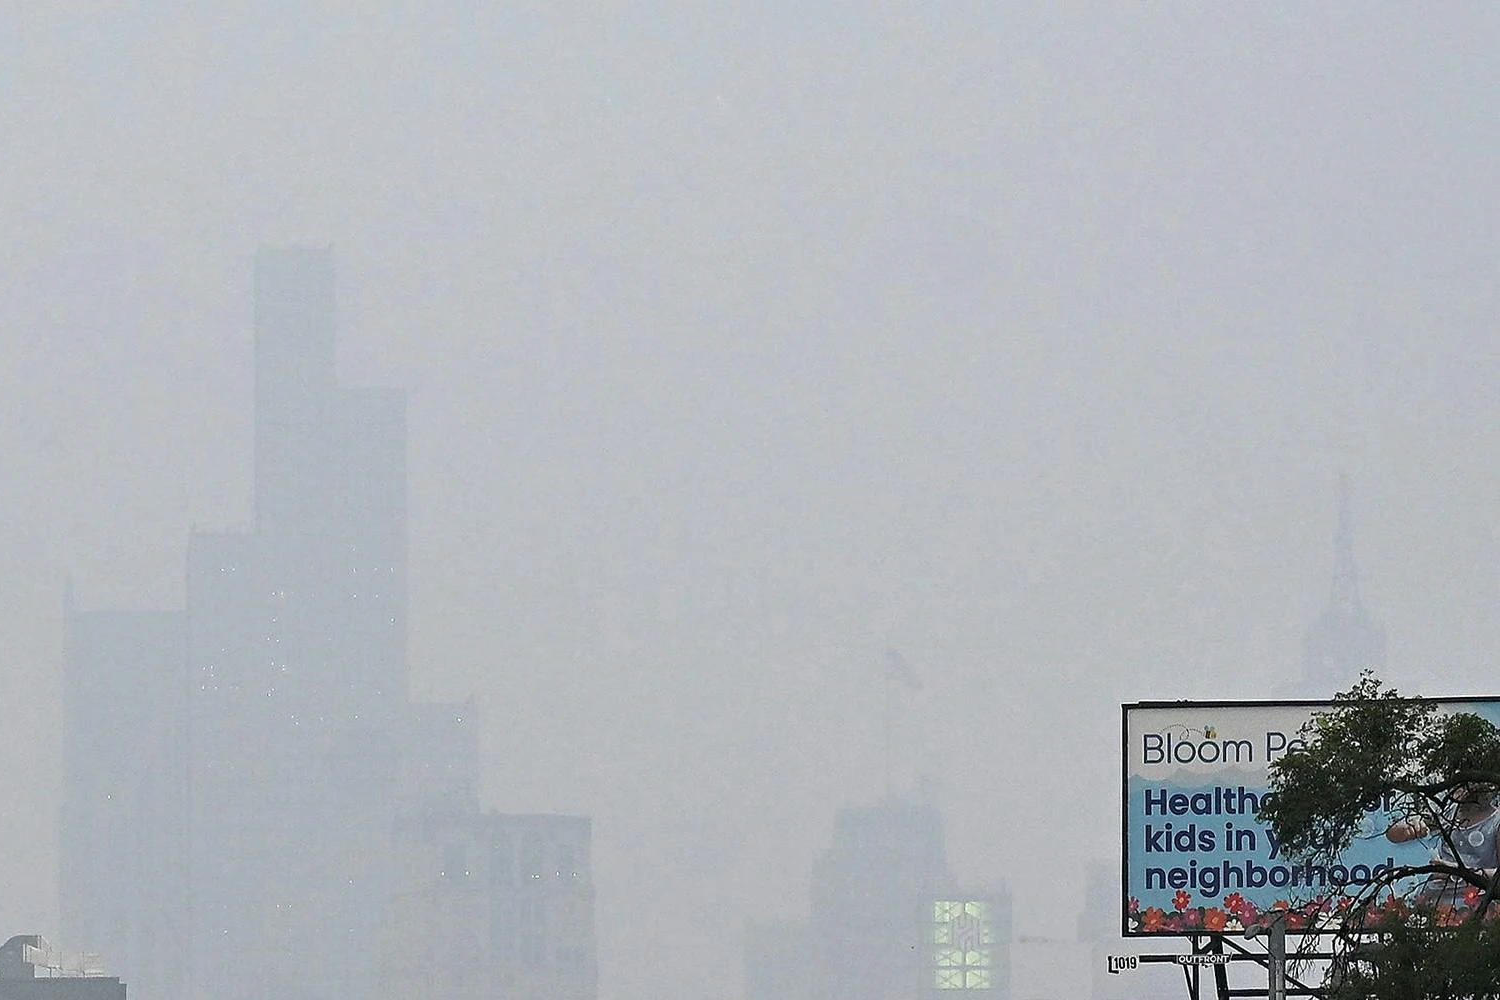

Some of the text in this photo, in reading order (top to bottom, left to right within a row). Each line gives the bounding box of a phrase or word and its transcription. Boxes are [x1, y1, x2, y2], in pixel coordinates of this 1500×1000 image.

[1143, 733, 1252, 764] Bloom
[1145, 786, 1278, 816] Healthc
[1145, 822, 1216, 852] kids
[1226, 822, 1256, 852] in
[1113, 956, 1137, 970] 1019
